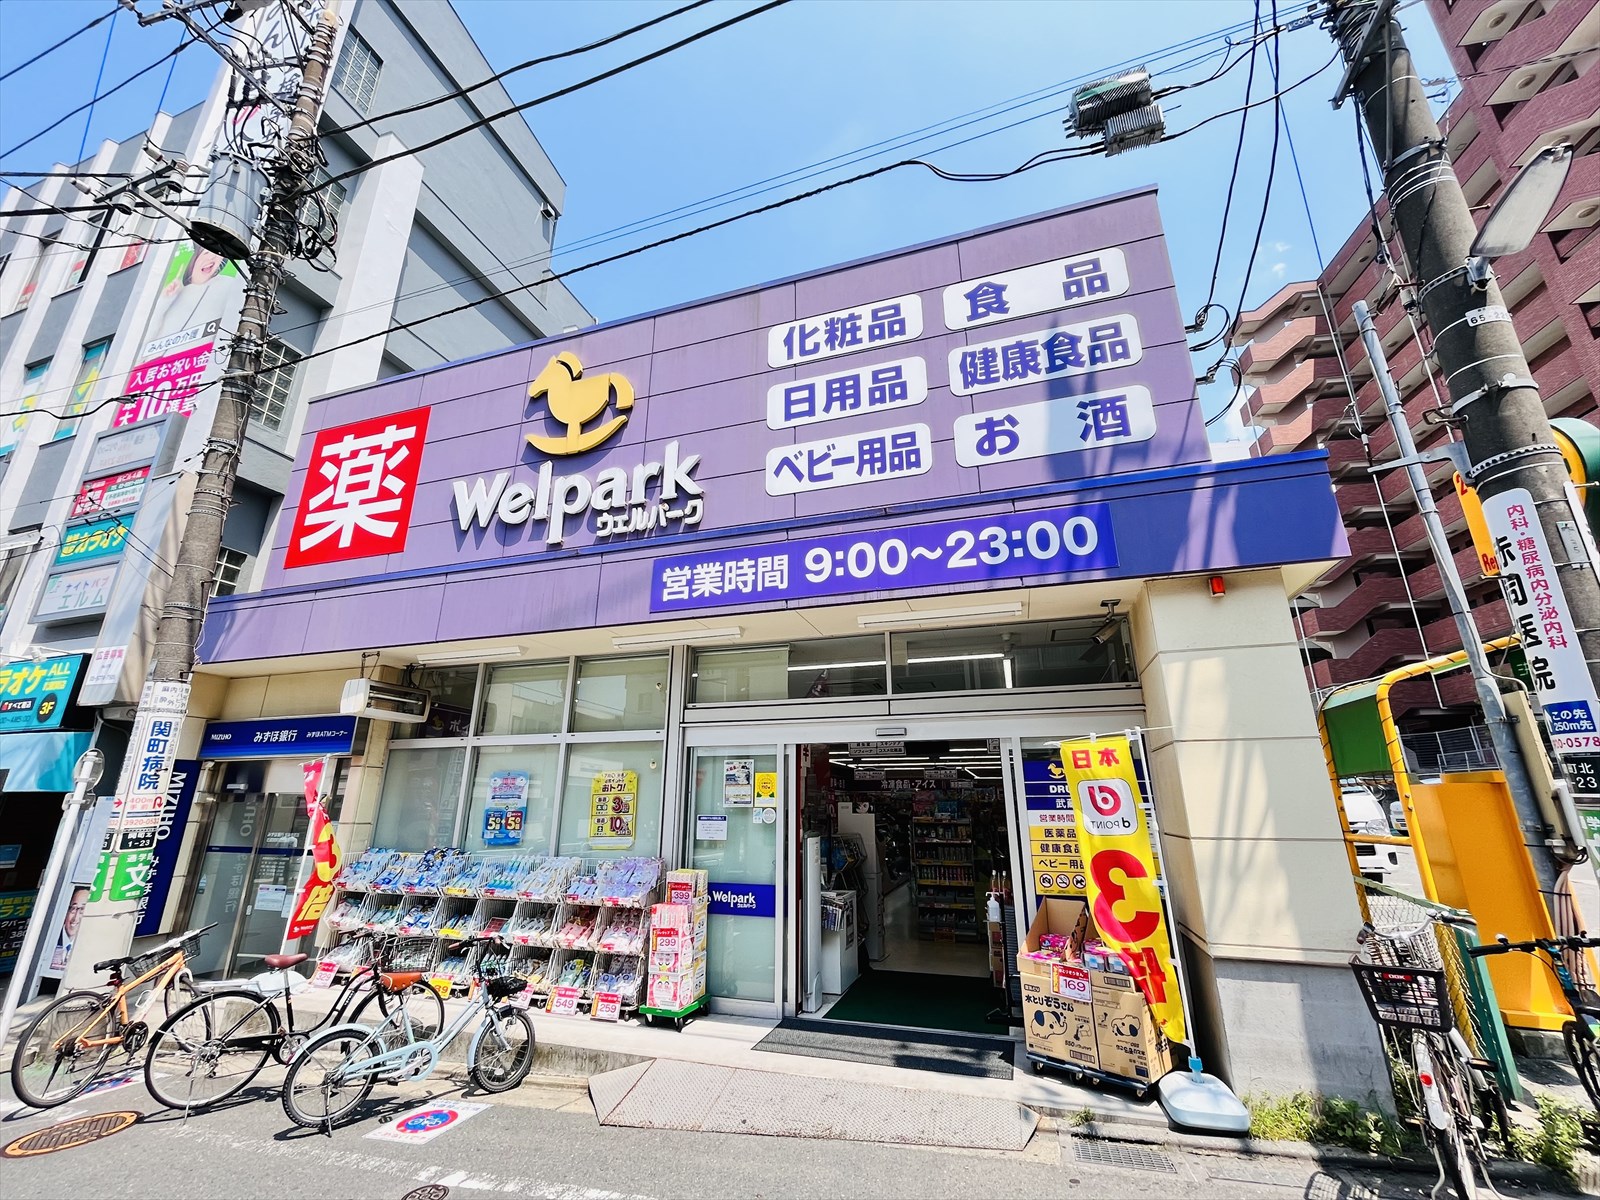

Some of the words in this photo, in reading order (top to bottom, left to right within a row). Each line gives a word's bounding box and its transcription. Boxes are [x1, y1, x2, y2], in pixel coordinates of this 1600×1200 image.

[963, 256, 1110, 322] 食品
[783, 302, 907, 361] 化粧品
[959, 322, 1132, 390] 健康食品
[130, 351, 211, 388] 入居お祝い金
[783, 365, 908, 422] 日用品
[975, 394, 1133, 457] お酒
[773, 431, 922, 484] ベビー用品
[300, 424, 417, 552] 薬
[453, 440, 705, 545] Welpark
[597, 499, 704, 537] ウェルパーク
[661, 554, 789, 602] 営業時間
[48, 661, 71, 676] ALL
[1551, 708, 1588, 721] この先
[210, 733, 232, 741] MIZUHO
[253, 729, 298, 743] みずほ銀行
[137, 720, 173, 790] 関町病院
[1044, 828, 1077, 838] 医薬品
[128, 840, 150, 848] 1-23
[121, 863, 150, 890] 文
[673, 891, 690, 900] 399
[712, 890, 756, 908] Welpark
[659, 938, 676, 947] 299
[316, 972, 331, 981] 329
[1063, 979, 1086, 992] 169
[555, 998, 574, 1009] 549
[600, 1003, 617, 1013] 259
[1025, 994, 1074, 1012] 水とりぞうさん
